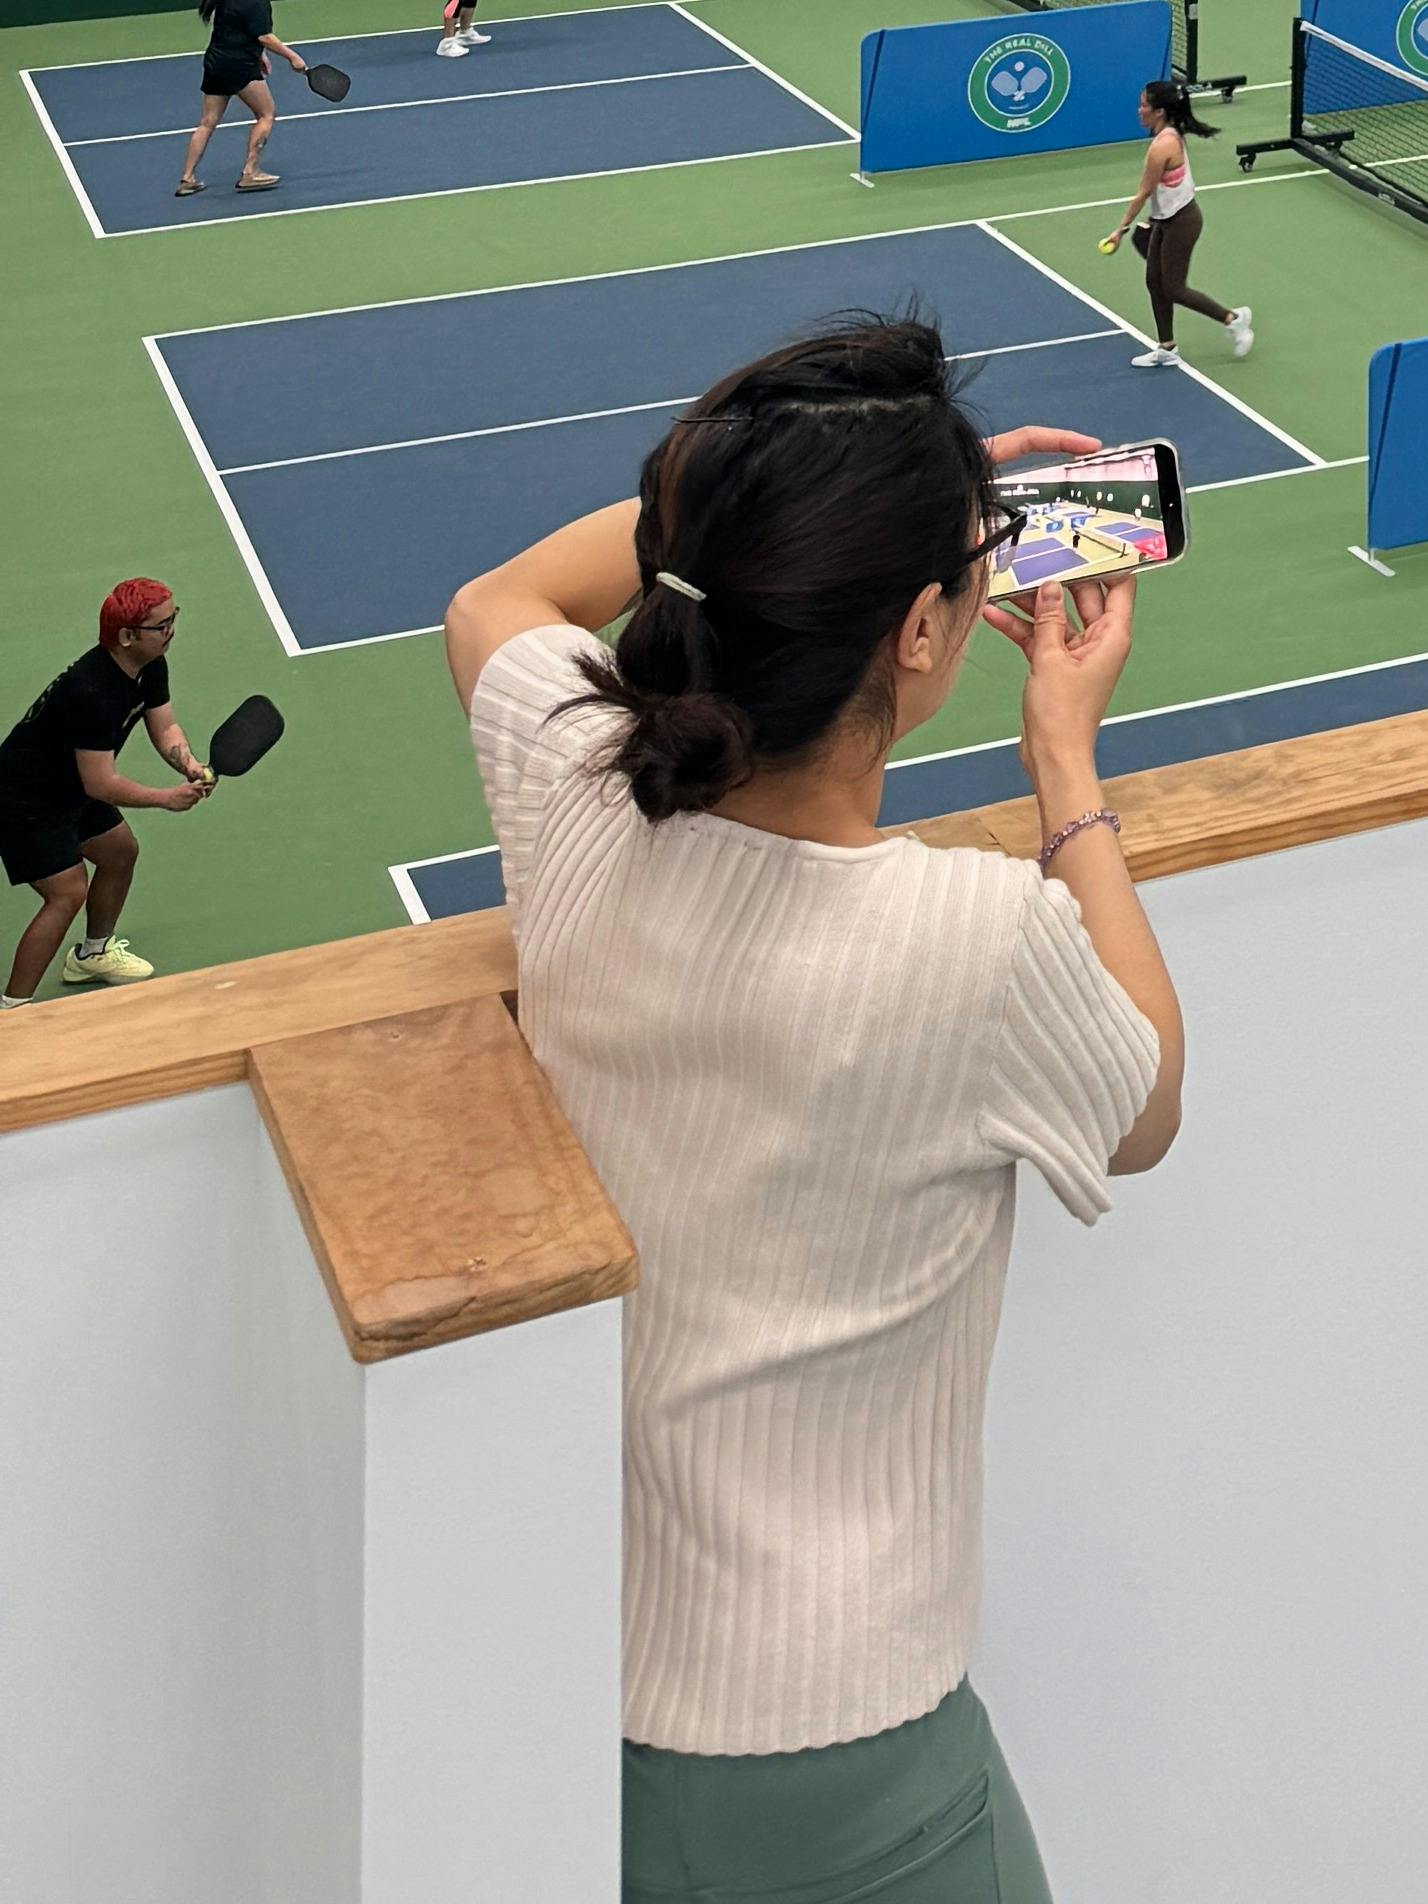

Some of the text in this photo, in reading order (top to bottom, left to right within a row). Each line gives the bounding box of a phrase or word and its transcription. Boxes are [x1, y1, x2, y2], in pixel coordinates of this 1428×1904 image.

[983, 38, 1054, 63] THE REAL DILL
